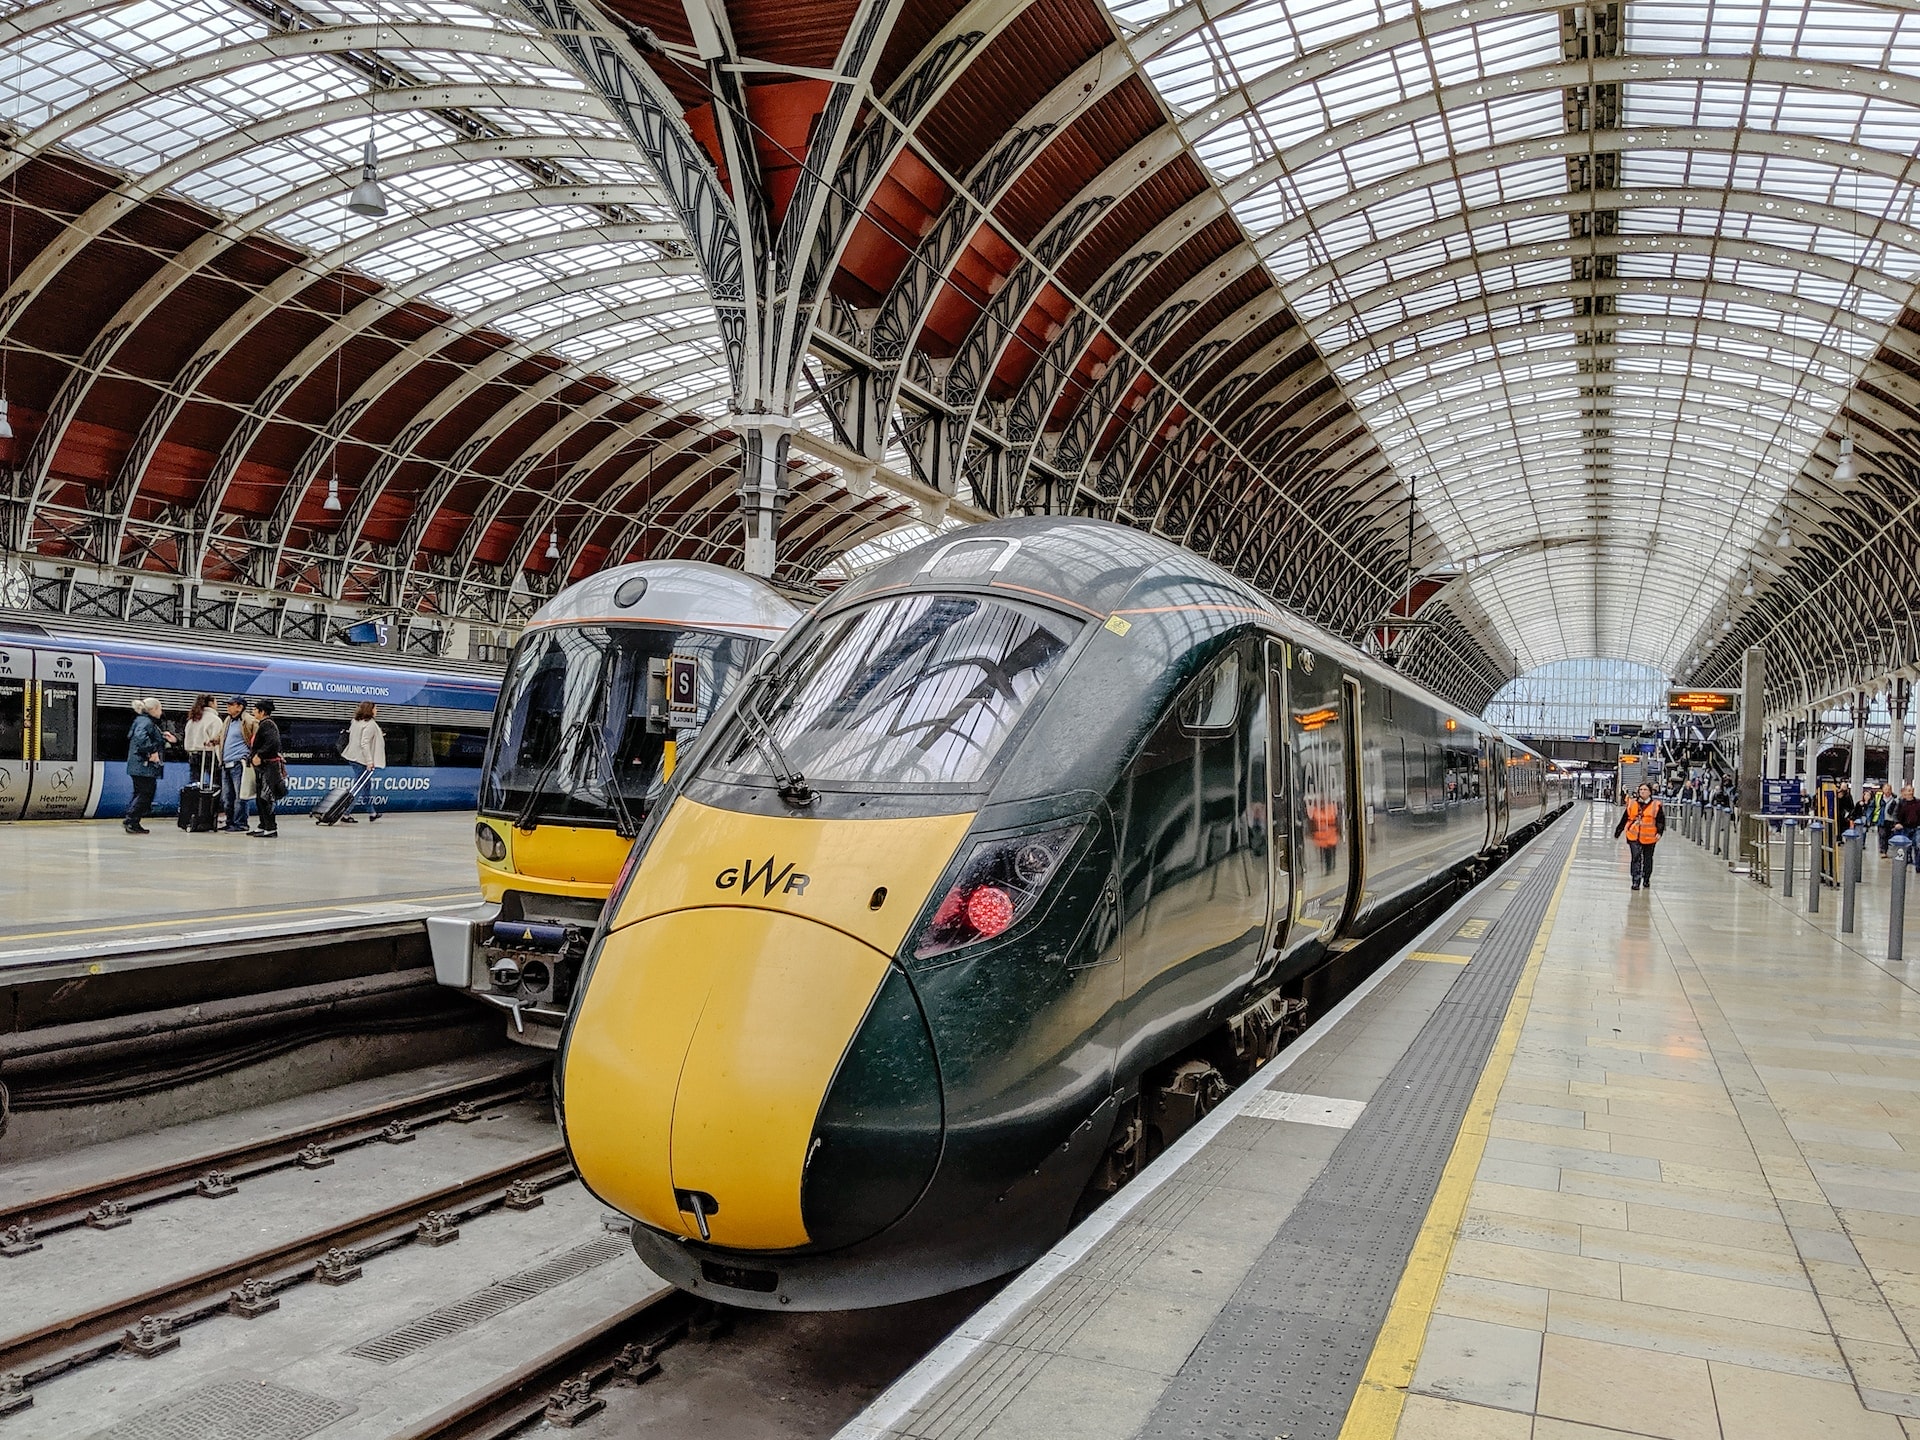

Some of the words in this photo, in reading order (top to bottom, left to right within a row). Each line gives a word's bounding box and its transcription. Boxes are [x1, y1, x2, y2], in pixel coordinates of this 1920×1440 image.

[380, 627, 388, 647] 5
[53, 670, 75, 679] TATA
[301, 681, 324, 691] TATA
[326, 683, 389, 696] COMMUNICATIONS
[679, 672, 690, 695] S
[44, 688, 53, 708] 1
[284, 776, 326, 791] RLD'S
[329, 776, 382, 791] BIGT
[384, 776, 430, 791] CLOUDS
[40, 794, 78, 803] Heathrow
[276, 796, 308, 807] WE'RE
[715, 853, 811, 898] GWR
